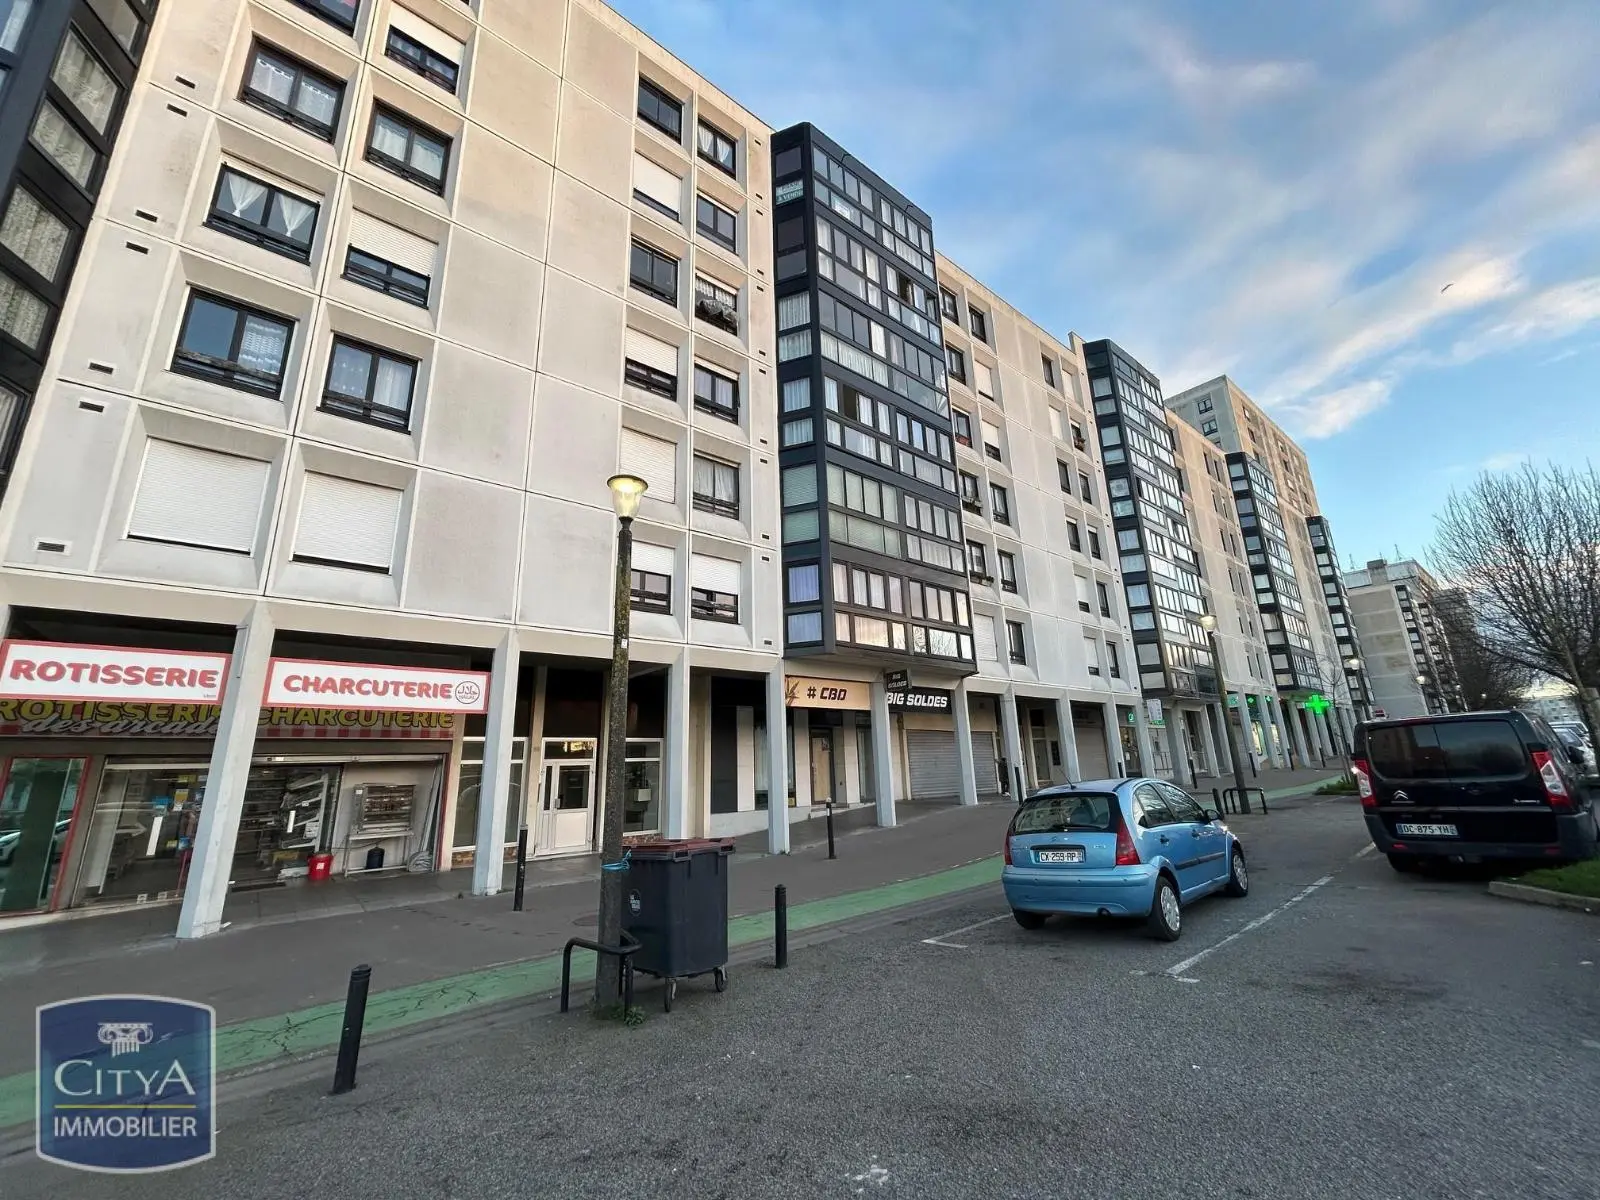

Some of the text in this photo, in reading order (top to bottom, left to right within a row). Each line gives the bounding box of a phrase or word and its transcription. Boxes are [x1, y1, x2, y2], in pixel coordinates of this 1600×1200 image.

[9, 659, 220, 688] ROTISSERIE
[283, 674, 453, 699] CHARCUTERIE
[820, 687, 848, 701] CBD
[0, 699, 221, 722] ROTISSERI
[887, 692, 948, 708] BIG SOLDES
